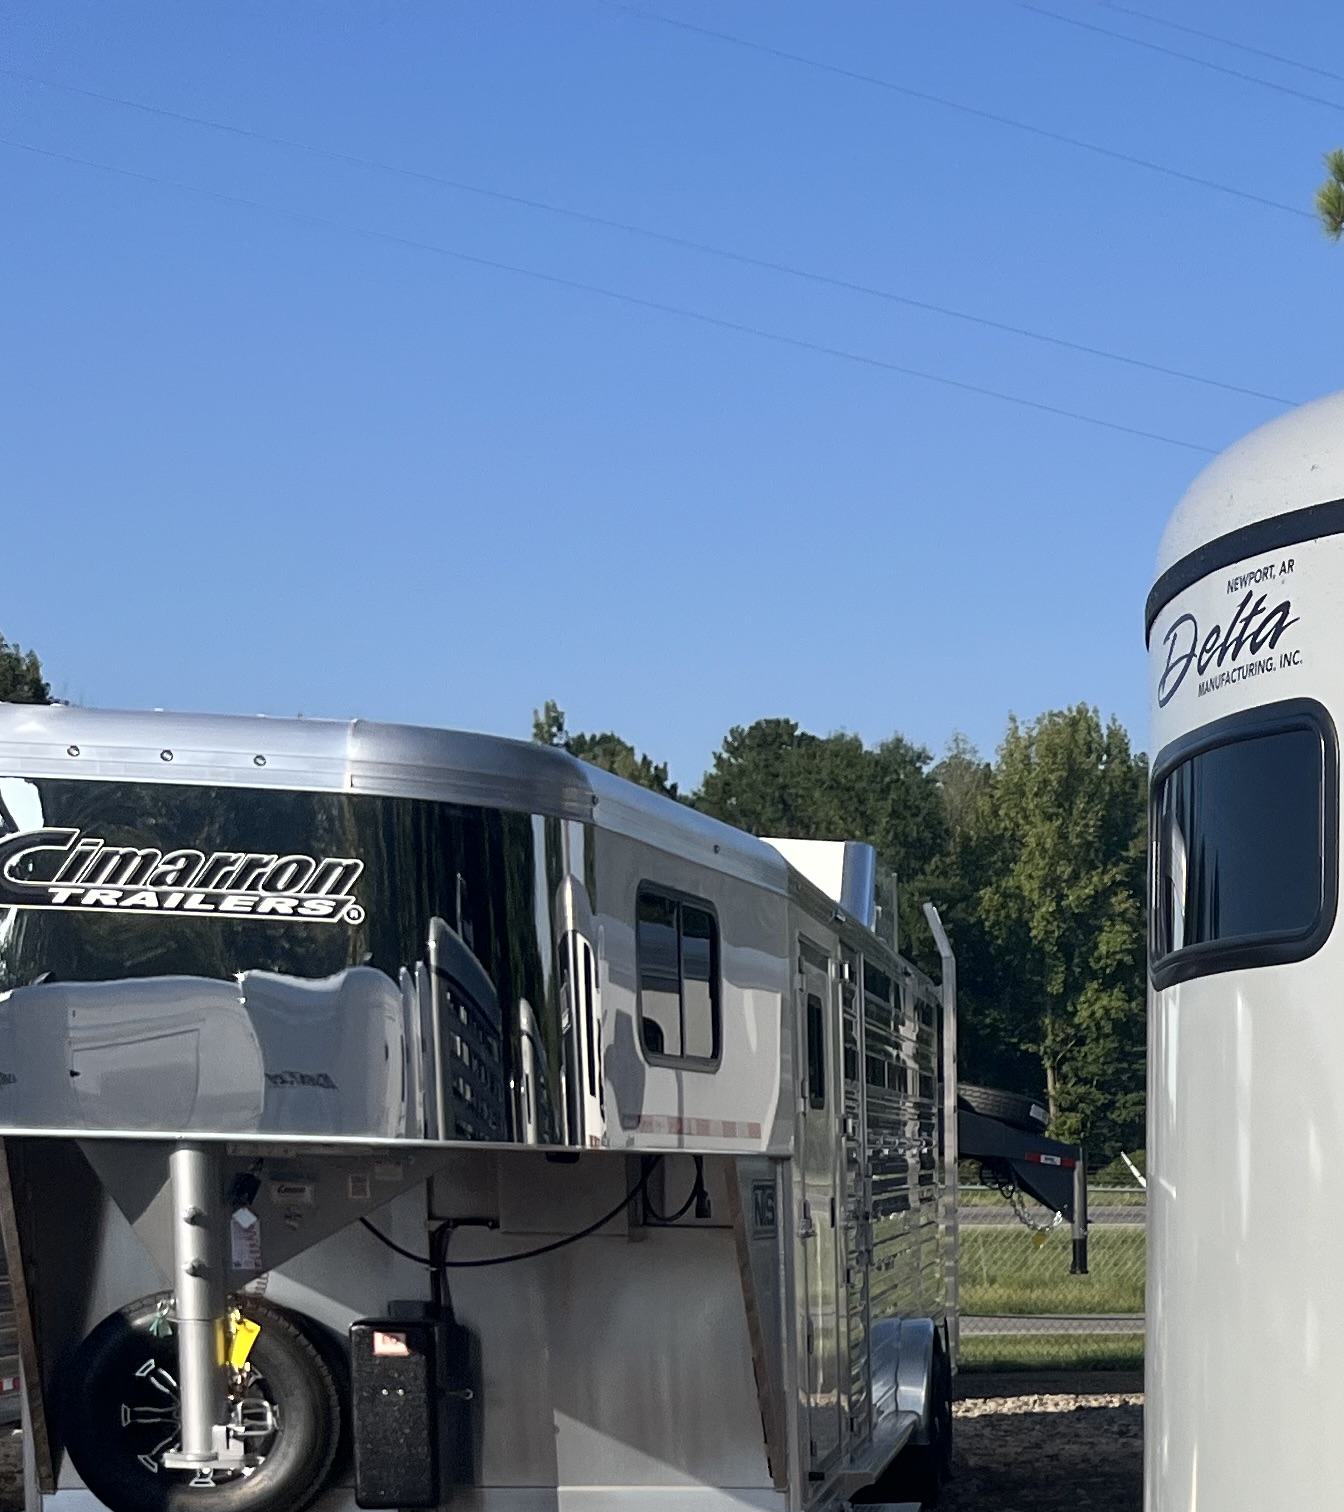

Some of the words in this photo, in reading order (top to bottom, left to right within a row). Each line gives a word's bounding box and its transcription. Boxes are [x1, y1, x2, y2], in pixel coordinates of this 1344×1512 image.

[1279, 558, 1295, 576] AR
[1158, 589, 1301, 709] Delta
[1279, 649, 1303, 669] INC.
[0, 828, 365, 897] Cimarron
[47, 886, 338, 917] TRAILERS
